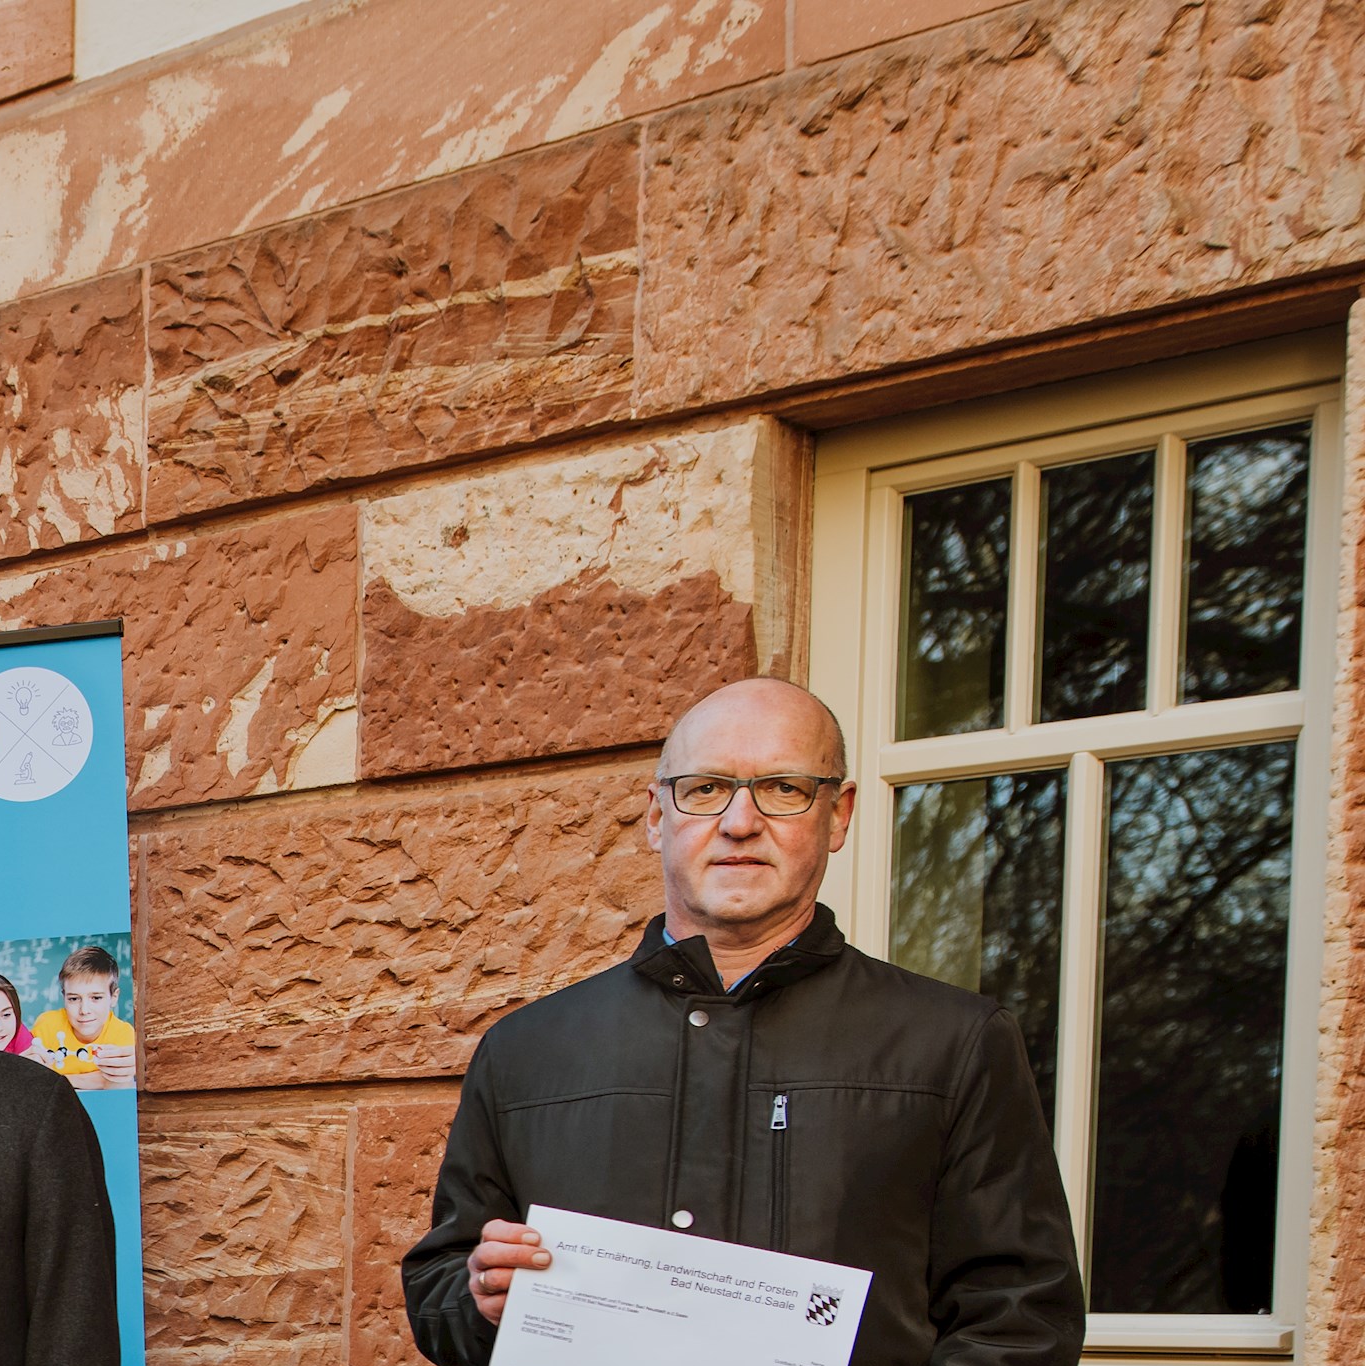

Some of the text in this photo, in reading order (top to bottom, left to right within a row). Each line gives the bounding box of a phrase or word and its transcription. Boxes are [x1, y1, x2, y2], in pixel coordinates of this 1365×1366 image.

[556, 1241, 799, 1298] Amt für Ernährung, Landwirtschaft und Forsten
[670, 1276, 796, 1311] Bad Neustadt a.d.Saale
